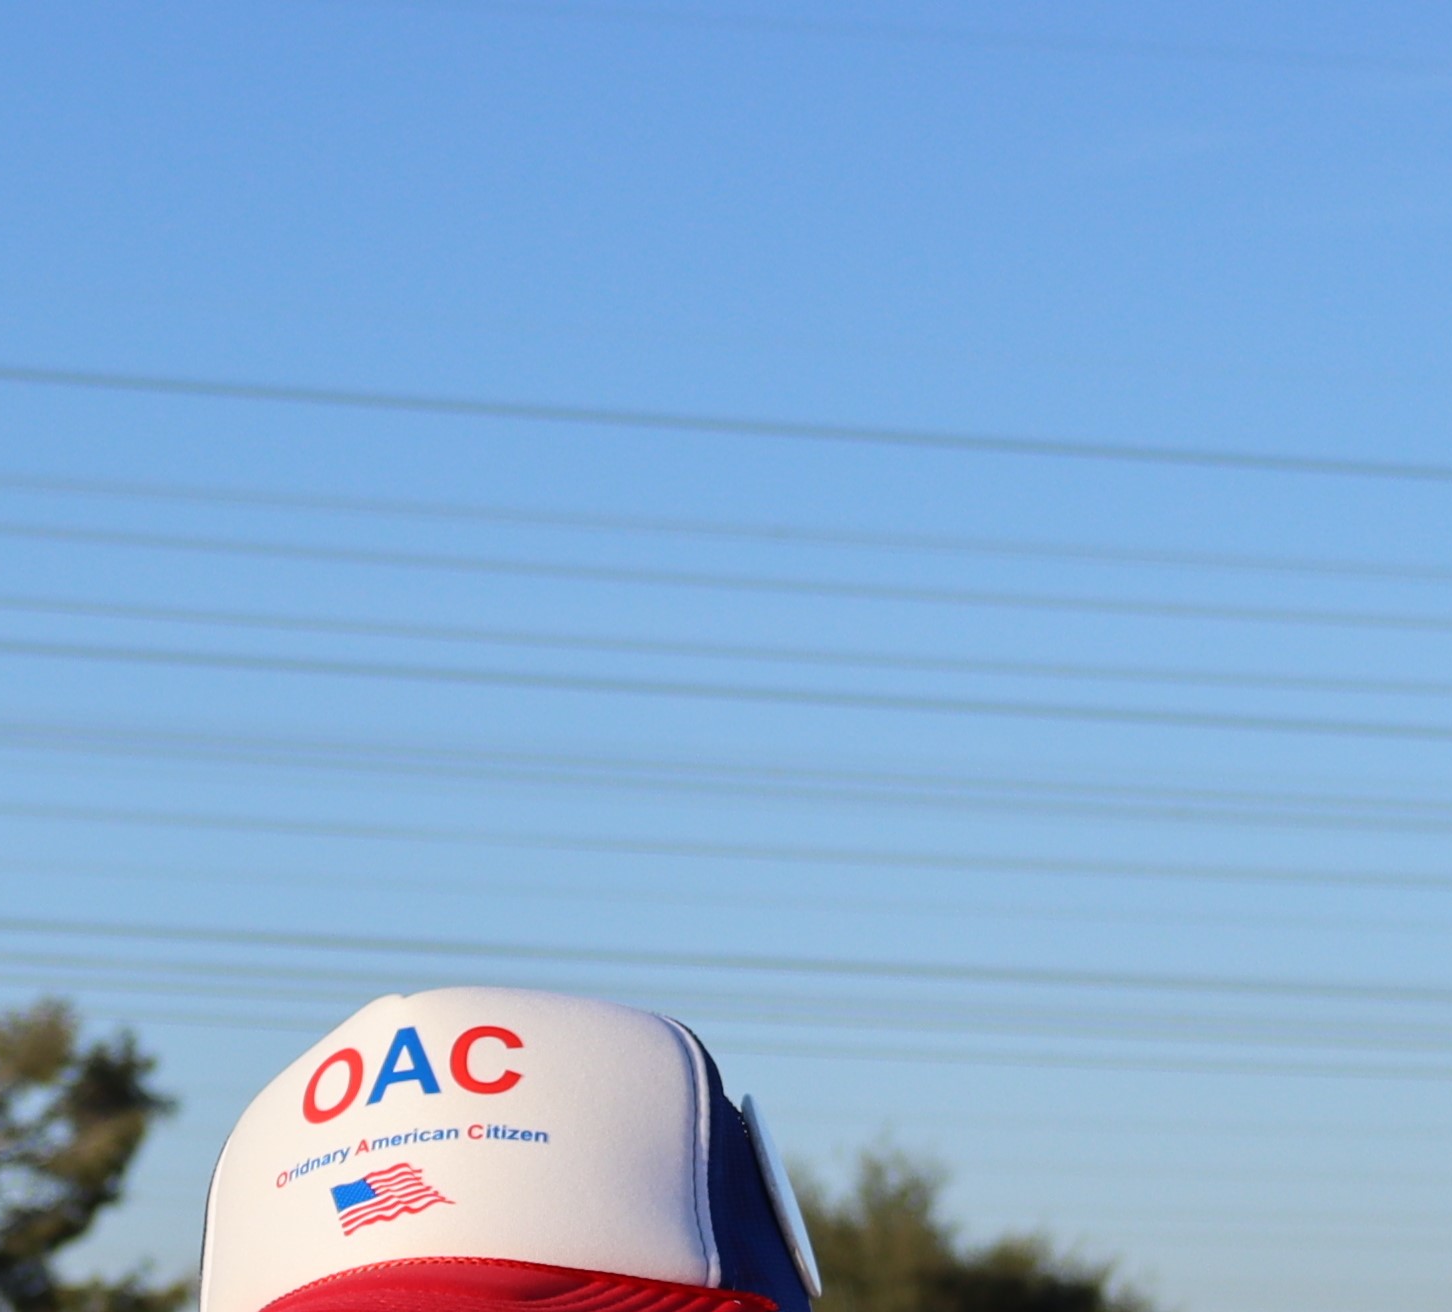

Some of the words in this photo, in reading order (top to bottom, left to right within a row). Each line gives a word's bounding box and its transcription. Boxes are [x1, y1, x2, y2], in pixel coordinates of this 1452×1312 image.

[302, 1025, 525, 1125] OAC
[276, 1146, 351, 1188] Oridnary
[355, 1127, 459, 1156] American
[467, 1124, 550, 1144] Citizen
